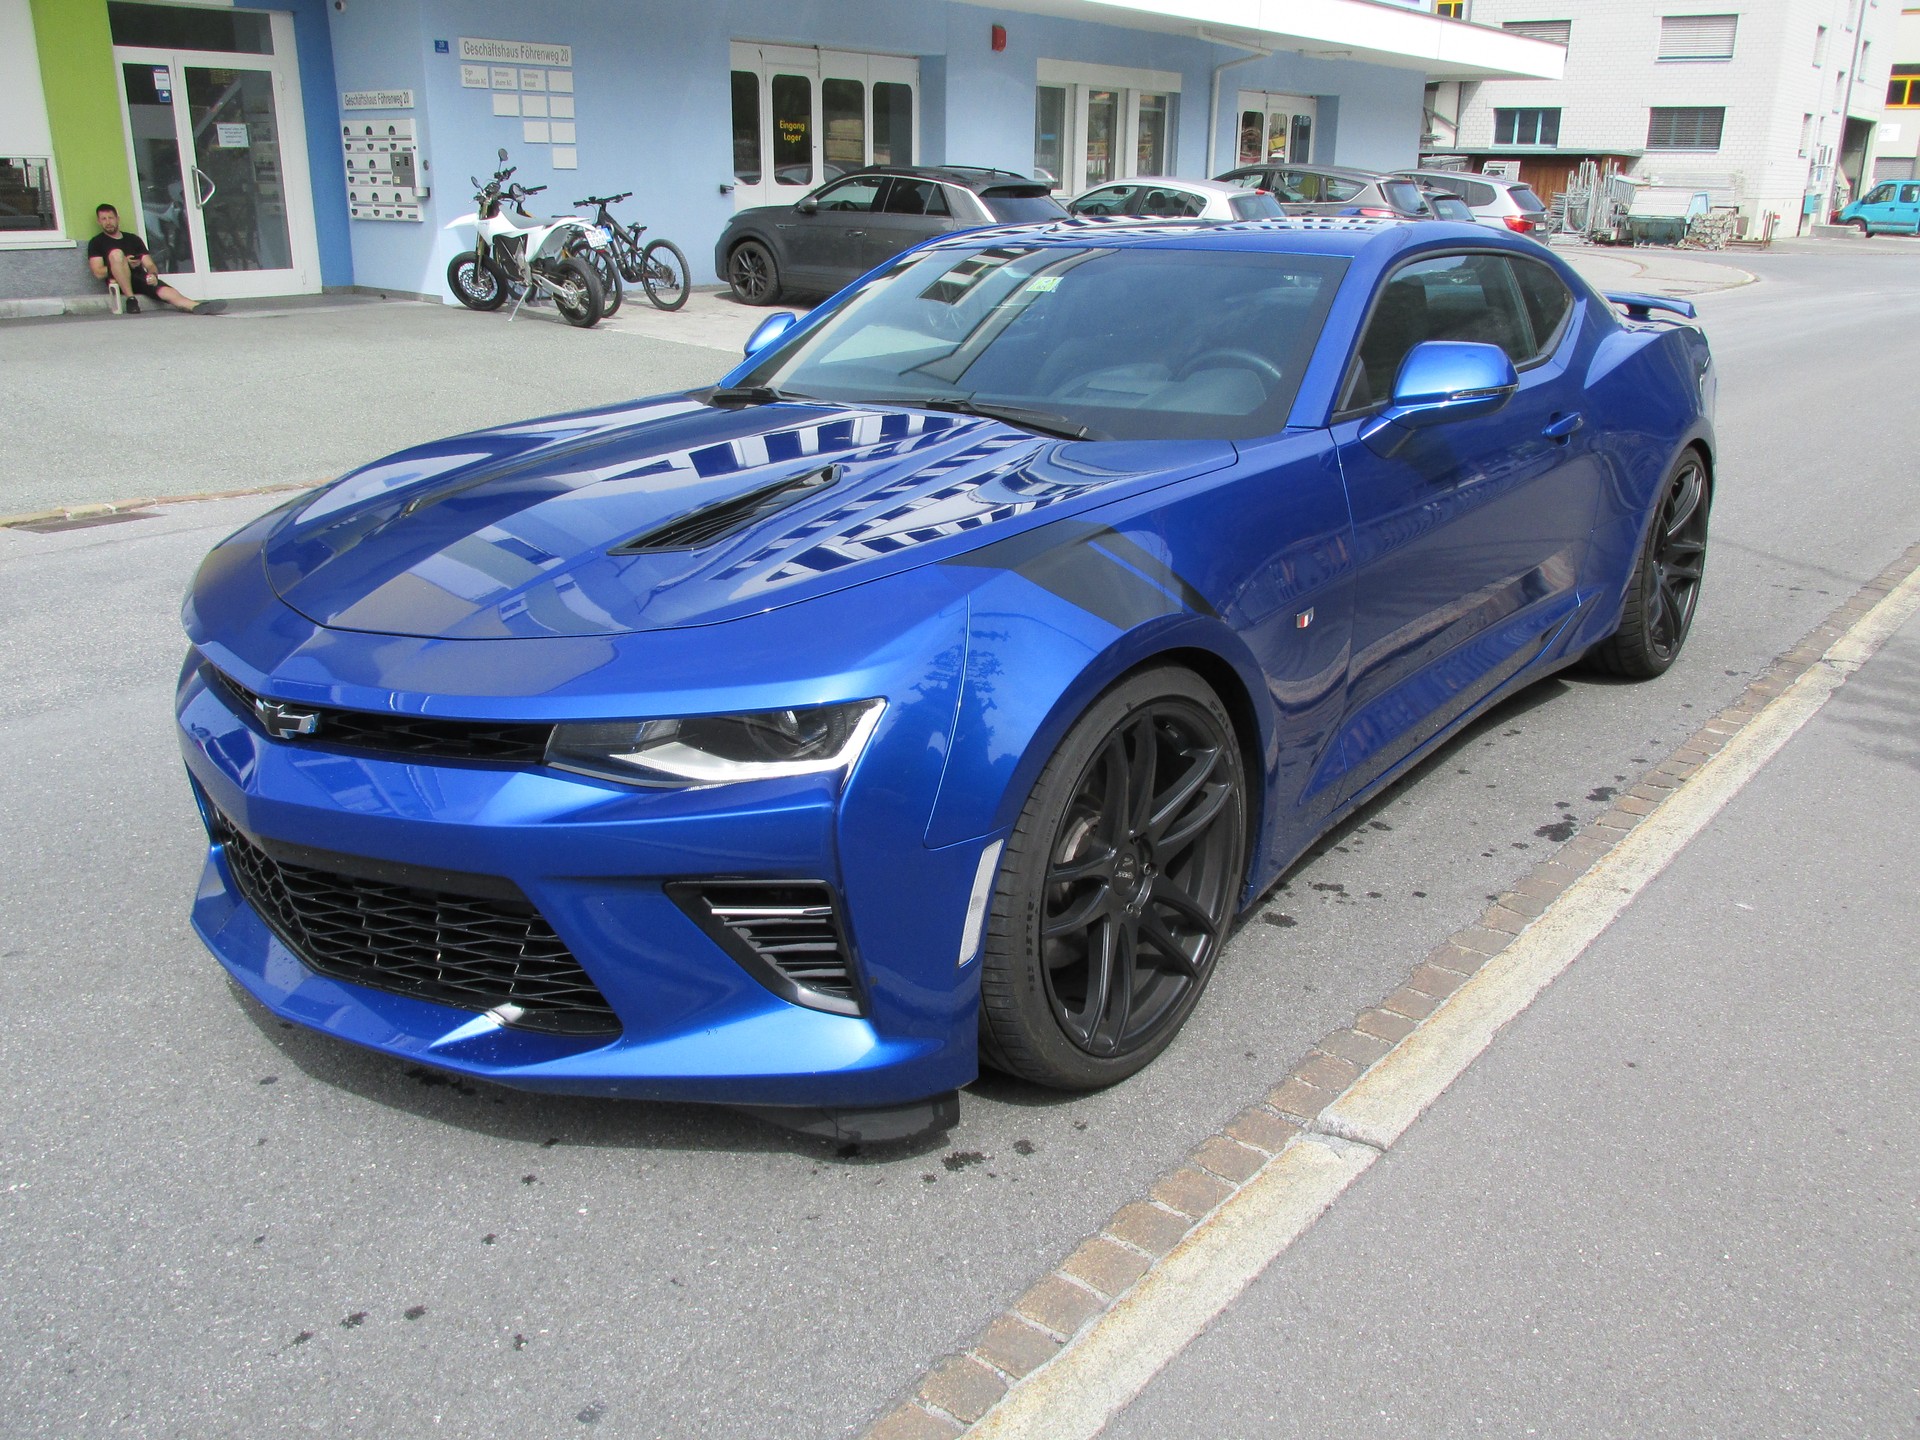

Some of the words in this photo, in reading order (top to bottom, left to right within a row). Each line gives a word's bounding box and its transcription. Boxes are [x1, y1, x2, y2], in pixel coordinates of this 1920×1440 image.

[463, 41, 519, 58] Geschäftshaus
[520, 45, 559, 64] Föhrenweg
[560, 49, 569, 62] 20
[345, 94, 378, 106] Geschäftshaus
[378, 92, 403, 107] Föhrenweg
[403, 91, 410, 104] 20
[779, 120, 805, 131] Eingang
[783, 132, 801, 143] Lager
